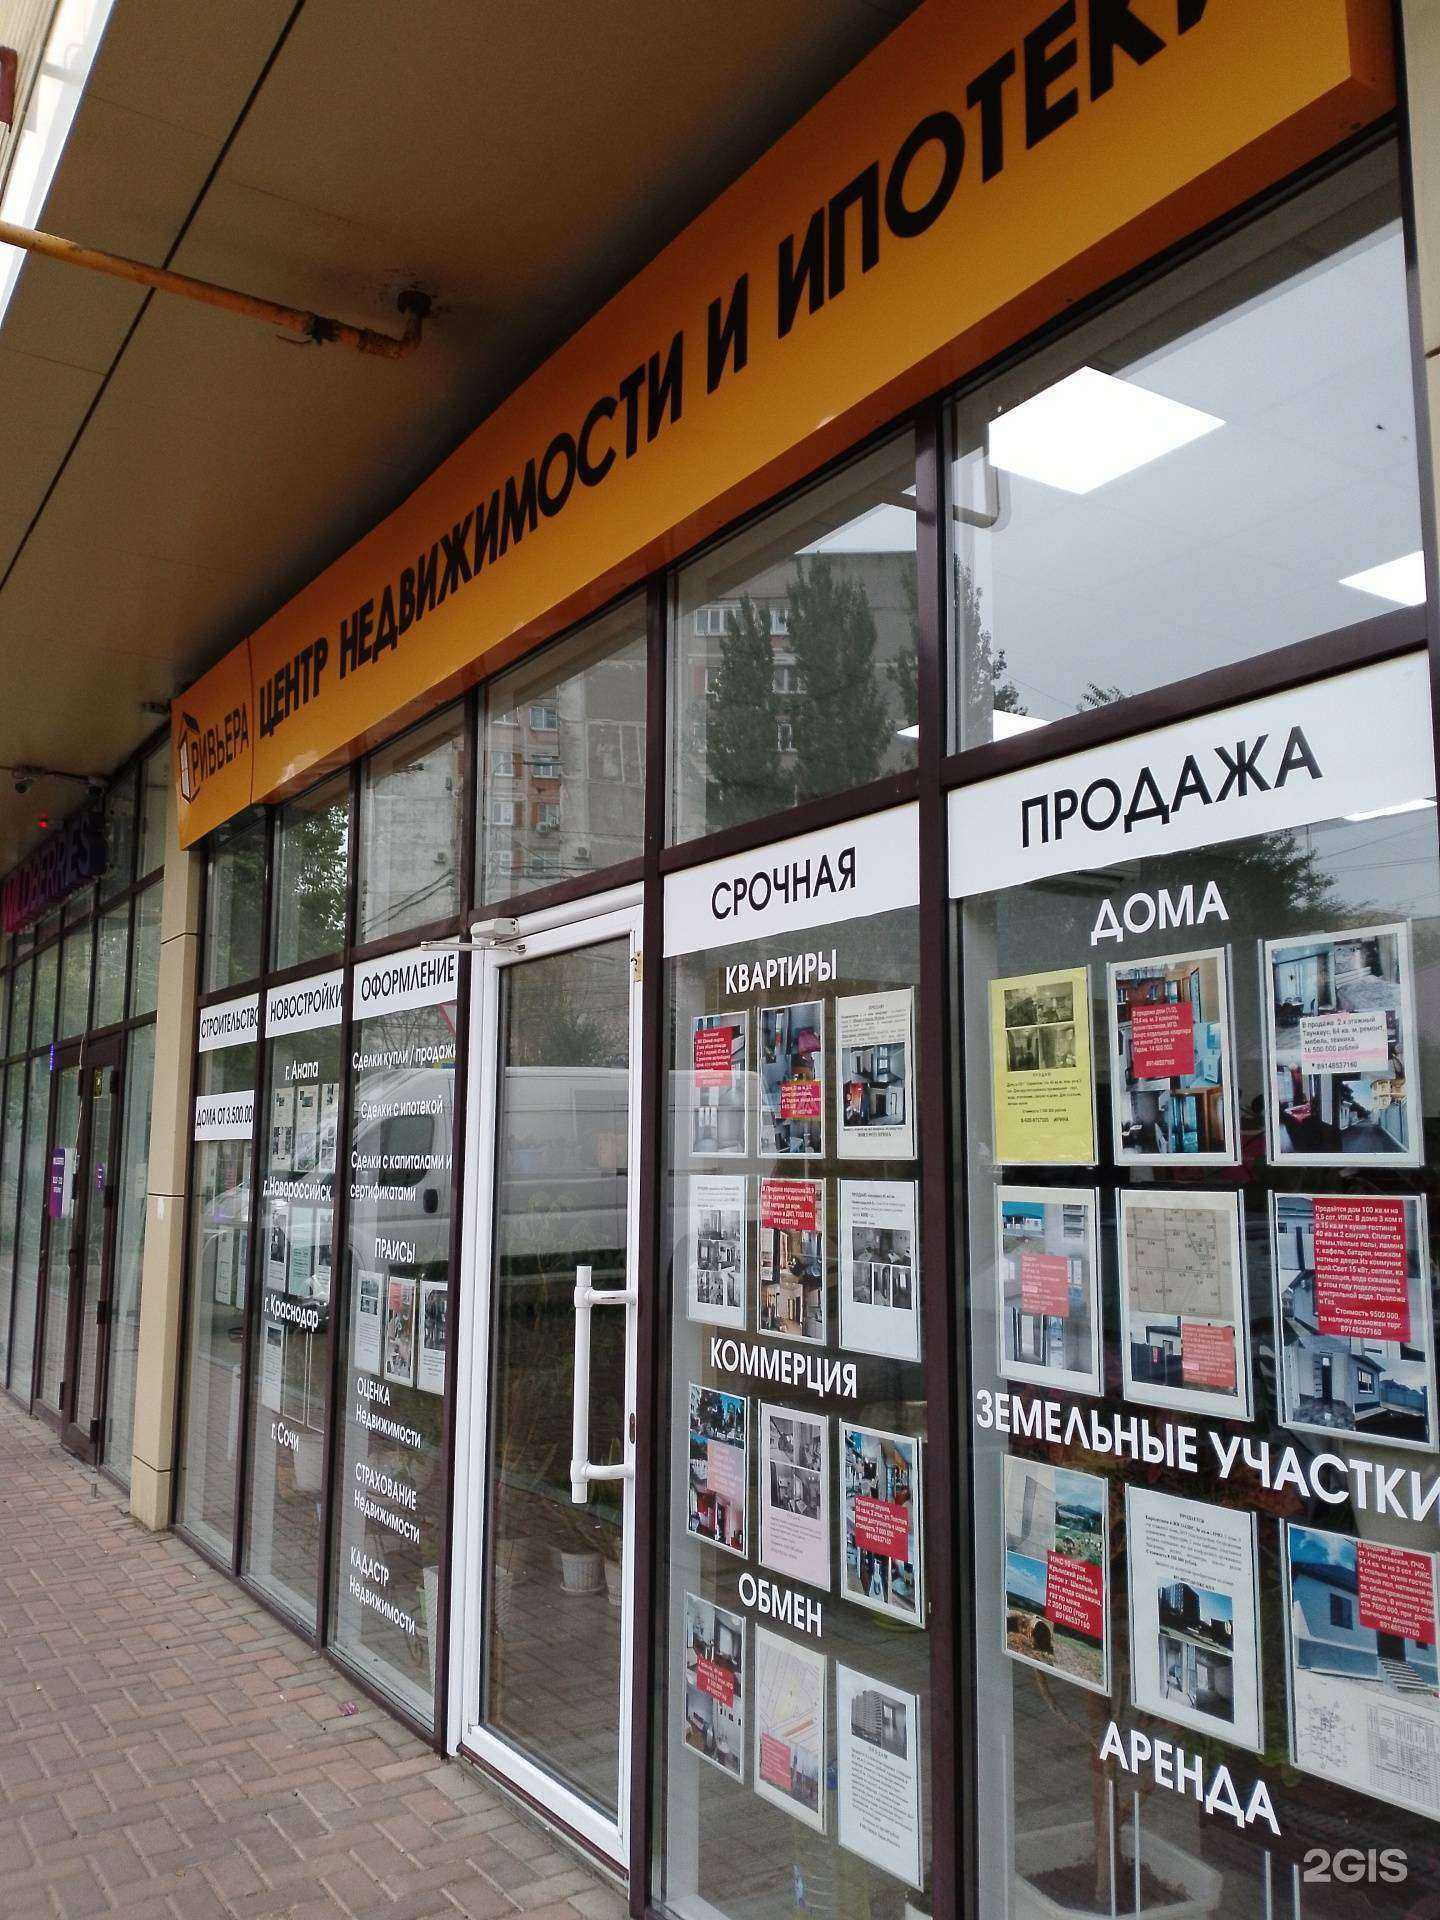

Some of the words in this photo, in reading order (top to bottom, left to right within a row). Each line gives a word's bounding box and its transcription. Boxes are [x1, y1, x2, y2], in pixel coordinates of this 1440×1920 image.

[259, 636, 328, 739] ЦЕНТР
[339, 330, 683, 680] НЕДВИЖИМОСТИ
[707, 273, 748, 395] И
[191, 703, 249, 787] РИВЬЕРА
[1021, 725, 1323, 848] ПРОДАЖА
[711, 847, 856, 921] СРОЧНАЯ
[1090, 881, 1229, 946] ДОМА
[361, 954, 455, 1002] ОФОРМЛЕНИЕ
[725, 949, 838, 994] КВАРТИРЫ
[201, 1006, 259, 1039] СТРОИТЕЛЬСТВО
[270, 982, 343, 1022] НОВОСТРОЙКИ
[291, 1060, 319, 1081] Анапа
[352, 1051, 382, 1071] Сделки
[361, 1101, 392, 1121] Сделки
[400, 1094, 443, 1117] ипотекой
[351, 1150, 382, 1171] Сделки
[389, 1154, 444, 1170] капиталами
[269, 1176, 332, 1202] Новороссийск
[350, 1182, 416, 1203] сертификатами
[270, 1293, 319, 1332] Краснодар
[710, 1336, 858, 1399] КОММЕРЦИЯ
[357, 1376, 391, 1406] ОЦЕНКА
[277, 1421, 299, 1452] Сочи
[976, 1389, 1198, 1473] ЗЕМЕЛЬНЫЕ
[1209, 1431, 1440, 1522] УЧАСТКИ
[355, 1462, 417, 1511] СТРАХОВАНИЕ
[350, 1546, 390, 1587] КАДАСТР
[738, 1572, 823, 1638] ОБМЕН
[1100, 1720, 1282, 1836] АРЕНДА
